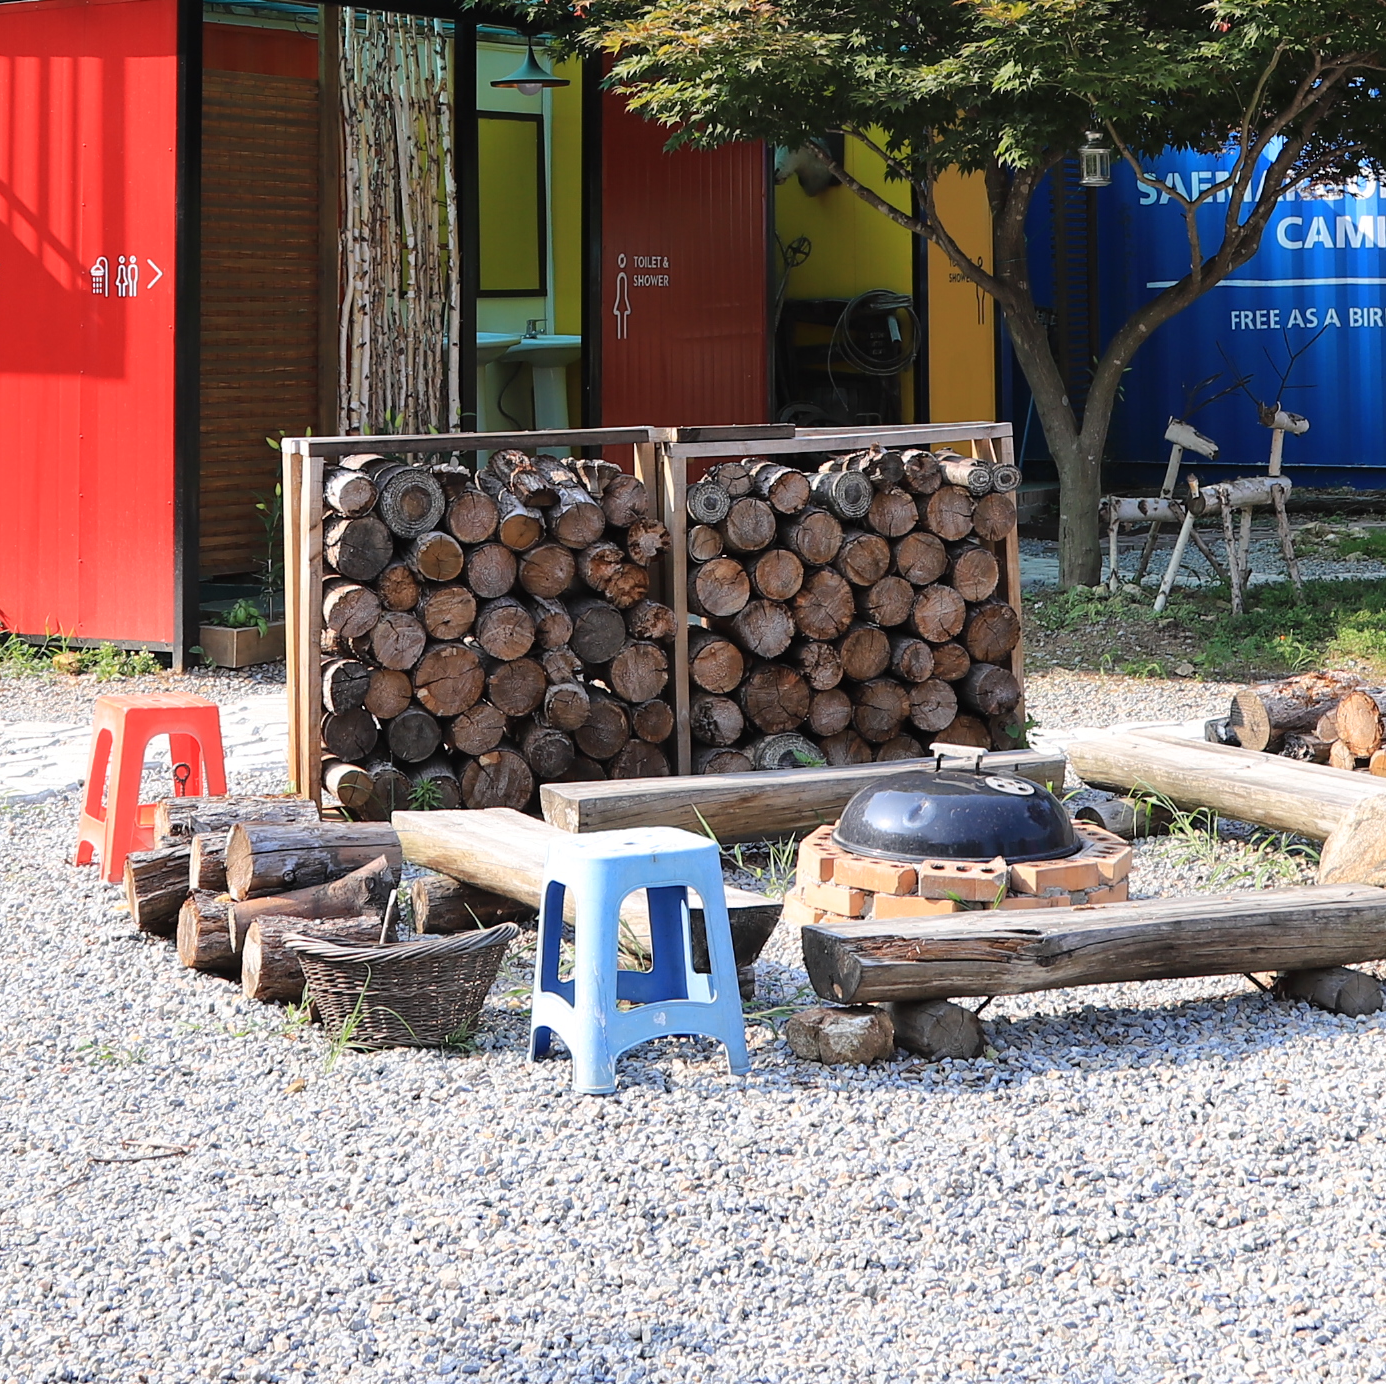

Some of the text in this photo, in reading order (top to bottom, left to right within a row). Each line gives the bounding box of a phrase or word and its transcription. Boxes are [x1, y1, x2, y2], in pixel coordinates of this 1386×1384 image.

[633, 256, 670, 268] TOILET &
[633, 274, 669, 287] SHOWER
[949, 273, 974, 283] SHOWE
[1230, 309, 1281, 331] FREE
[1286, 308, 1318, 329] AS
[1323, 307, 1342, 328] A
